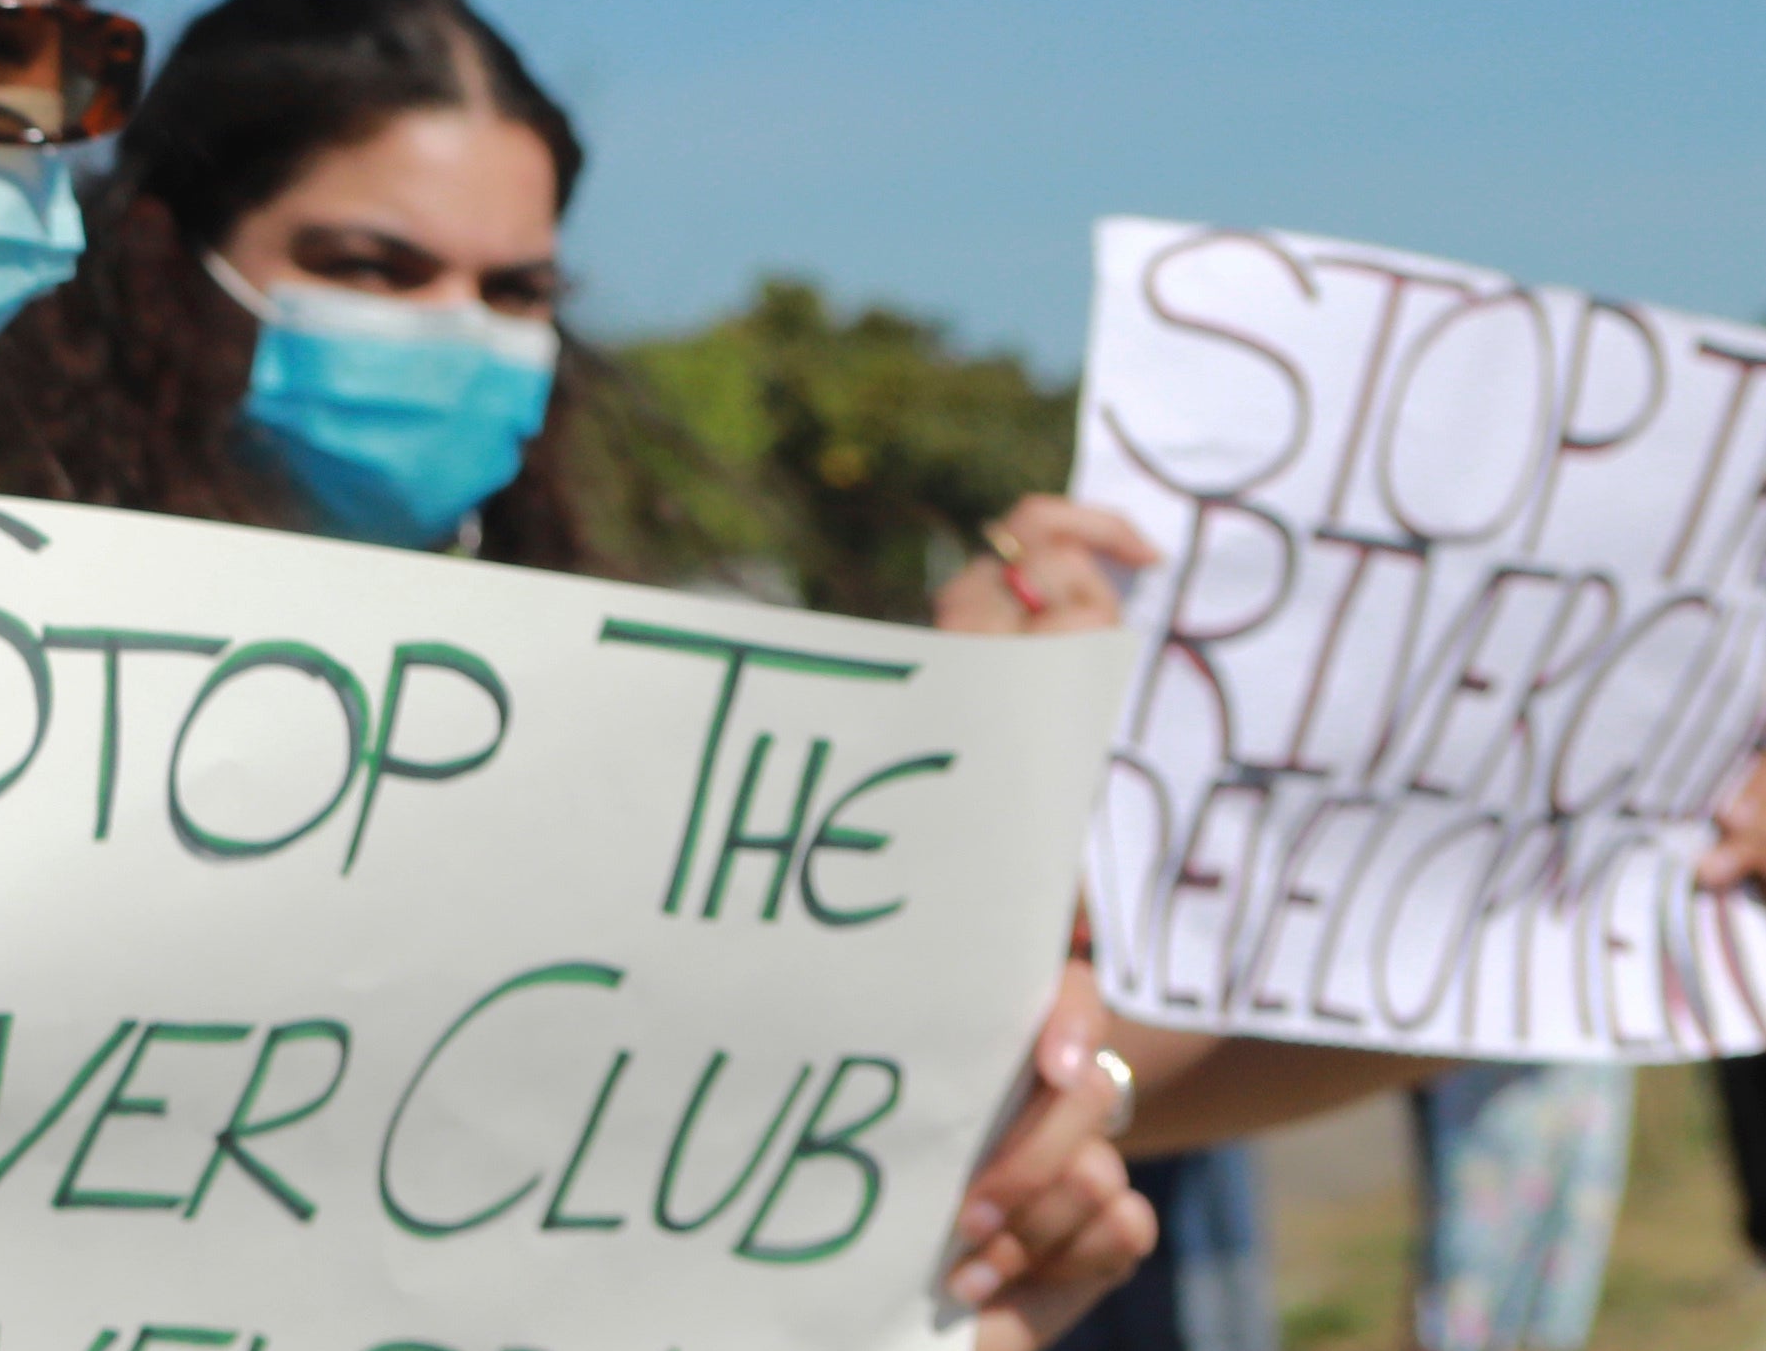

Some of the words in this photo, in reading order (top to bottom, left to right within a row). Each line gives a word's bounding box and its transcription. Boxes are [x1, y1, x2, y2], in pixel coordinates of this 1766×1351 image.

[1099, 229, 1667, 561] STOP
[601, 616, 955, 928] THE
[378, 962, 903, 1264] CLUB
